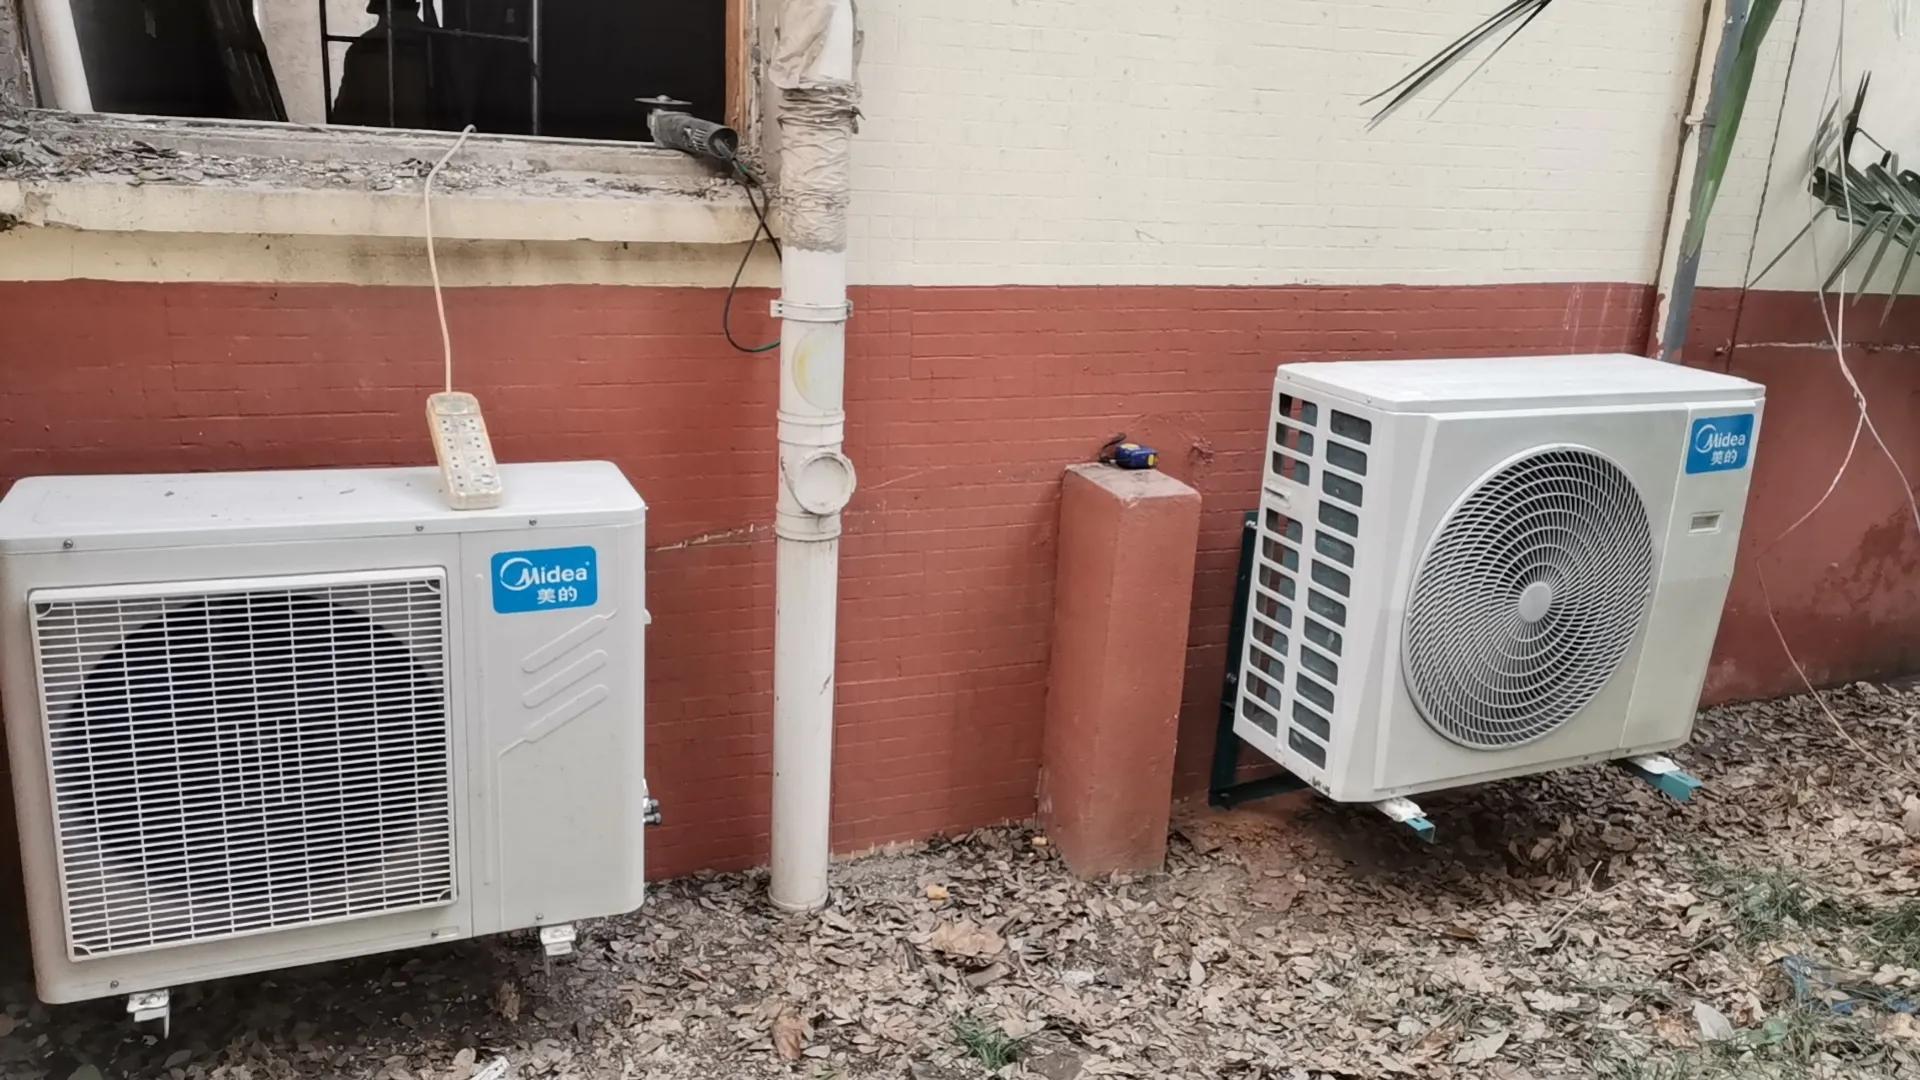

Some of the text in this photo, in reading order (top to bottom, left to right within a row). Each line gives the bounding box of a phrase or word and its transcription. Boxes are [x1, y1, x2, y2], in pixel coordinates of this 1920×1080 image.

[1695, 424, 1746, 453] Midea
[1710, 448, 1738, 465] 美的
[500, 557, 588, 591] Midea
[537, 586, 577, 604] 美的
